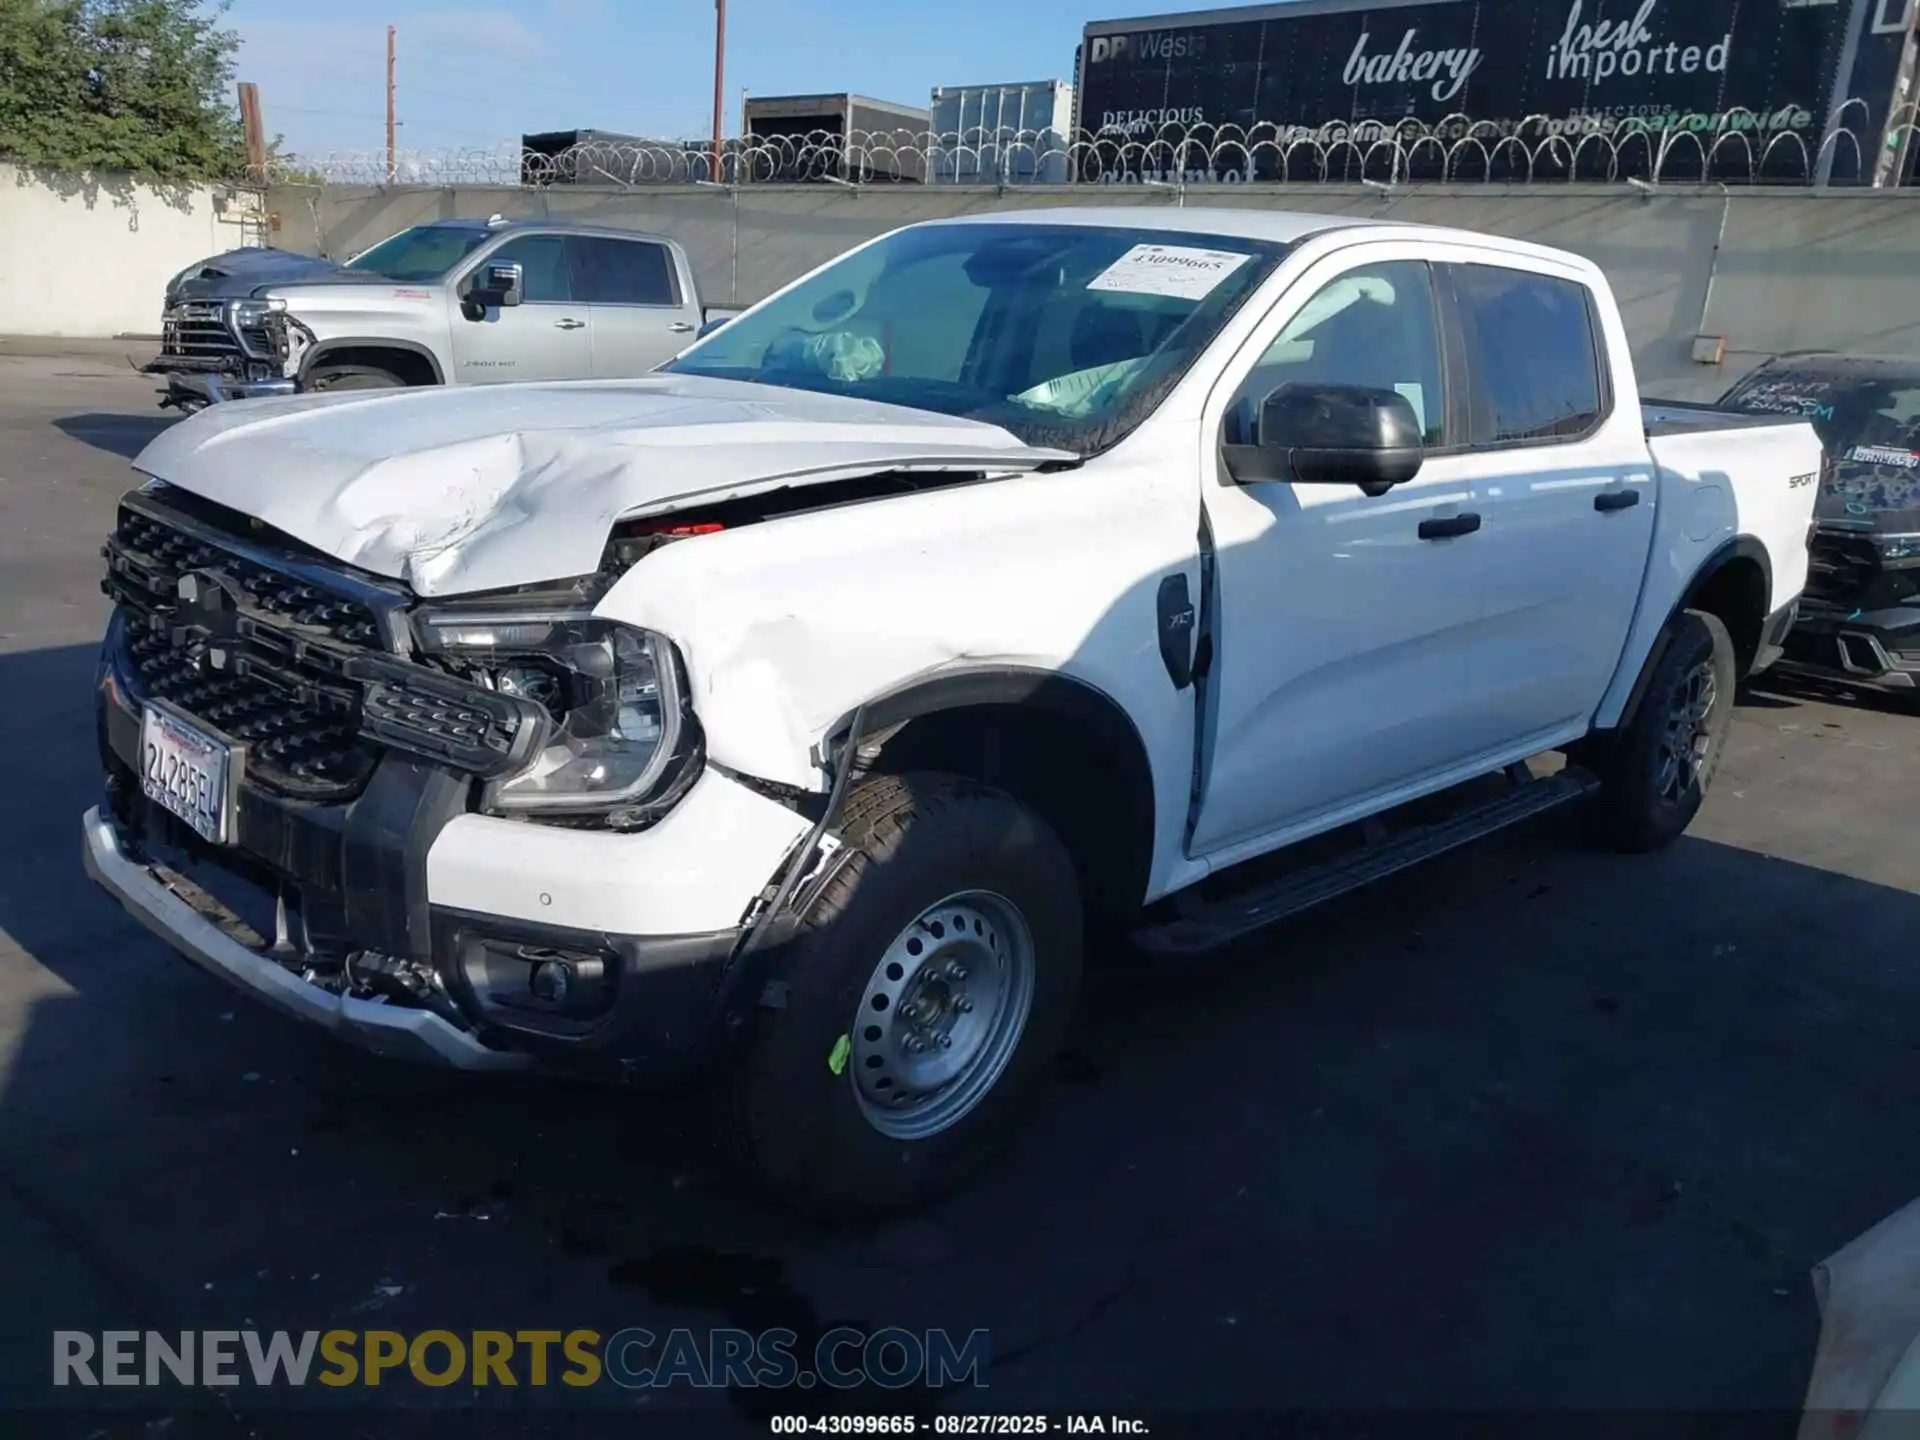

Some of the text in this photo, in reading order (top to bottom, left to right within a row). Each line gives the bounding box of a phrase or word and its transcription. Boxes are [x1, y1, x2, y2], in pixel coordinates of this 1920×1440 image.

[1546, 34, 1730, 86] imported
[1559, 0, 1656, 70] fresh
[1343, 28, 1484, 101] bakery
[1102, 107, 1203, 126] DELICIOUS
[1789, 471, 1817, 489] SPORT
